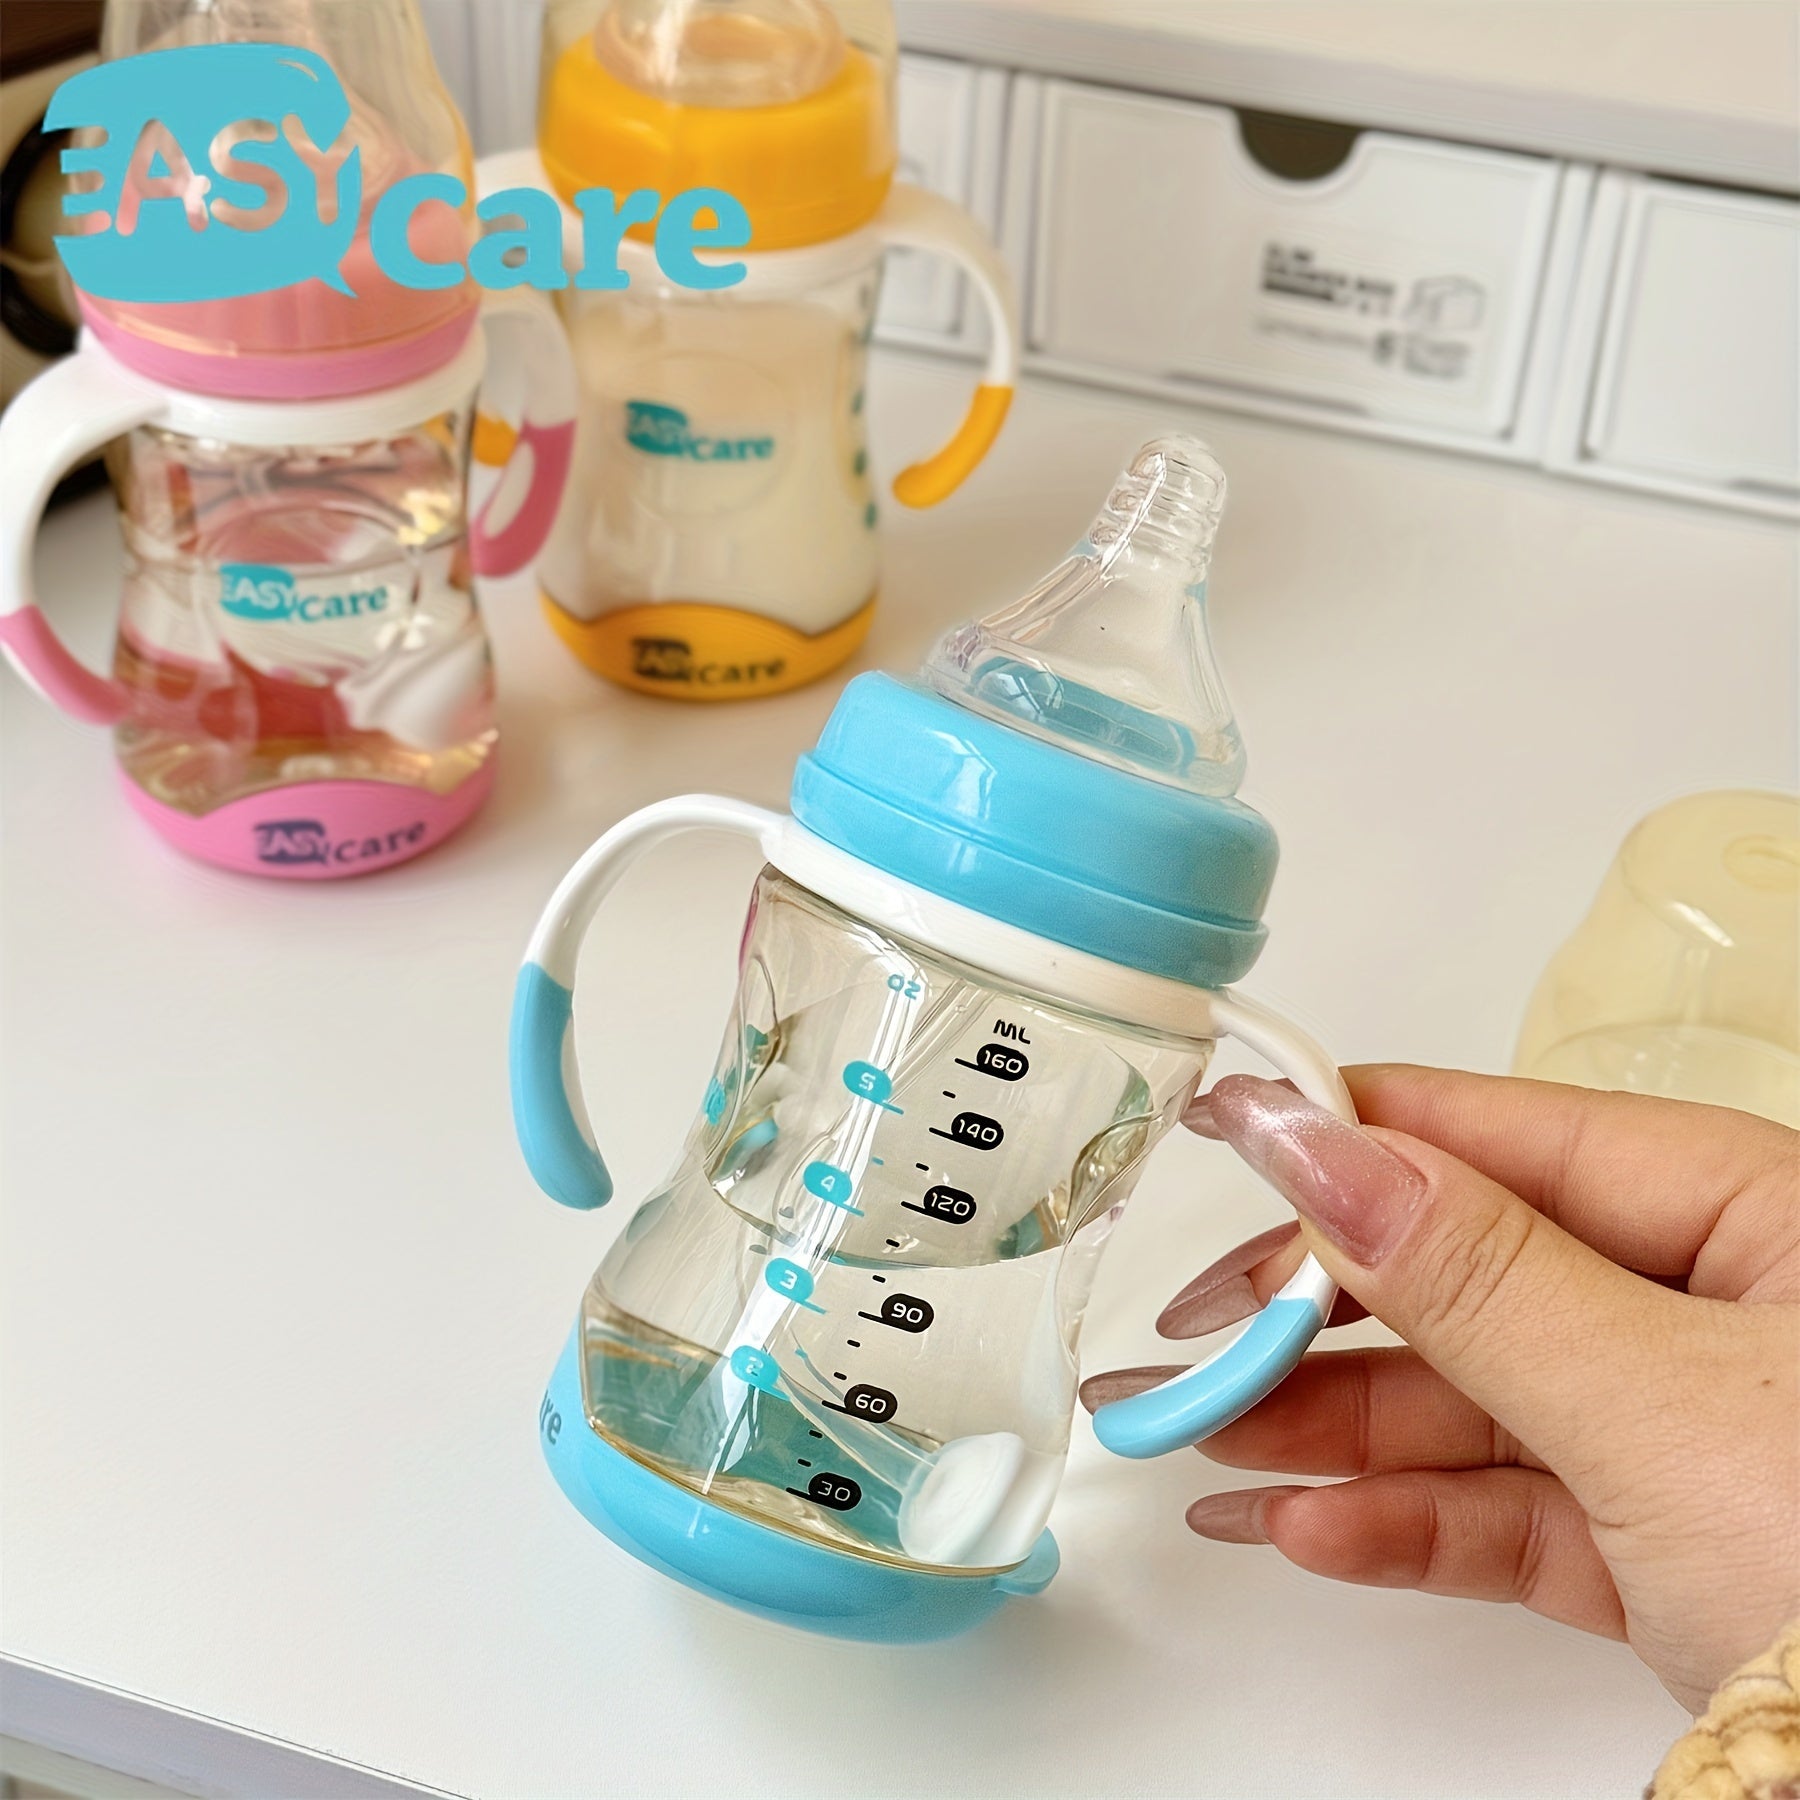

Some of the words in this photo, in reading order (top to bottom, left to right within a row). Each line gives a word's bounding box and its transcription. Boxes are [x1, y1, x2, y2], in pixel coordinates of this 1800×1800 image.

[298, 587, 389, 622] care
[333, 822, 427, 863] care
[887, 973, 922, 1000] OZ
[993, 1018, 1032, 1045] ML
[982, 1048, 1024, 1075] 160
[956, 1118, 999, 1144] 140
[819, 1174, 837, 1193] 4
[929, 1191, 971, 1218] 120
[779, 1269, 798, 1290] 3
[890, 1302, 924, 1325] 90
[854, 1392, 888, 1415] 60
[817, 1480, 851, 1502] 30
